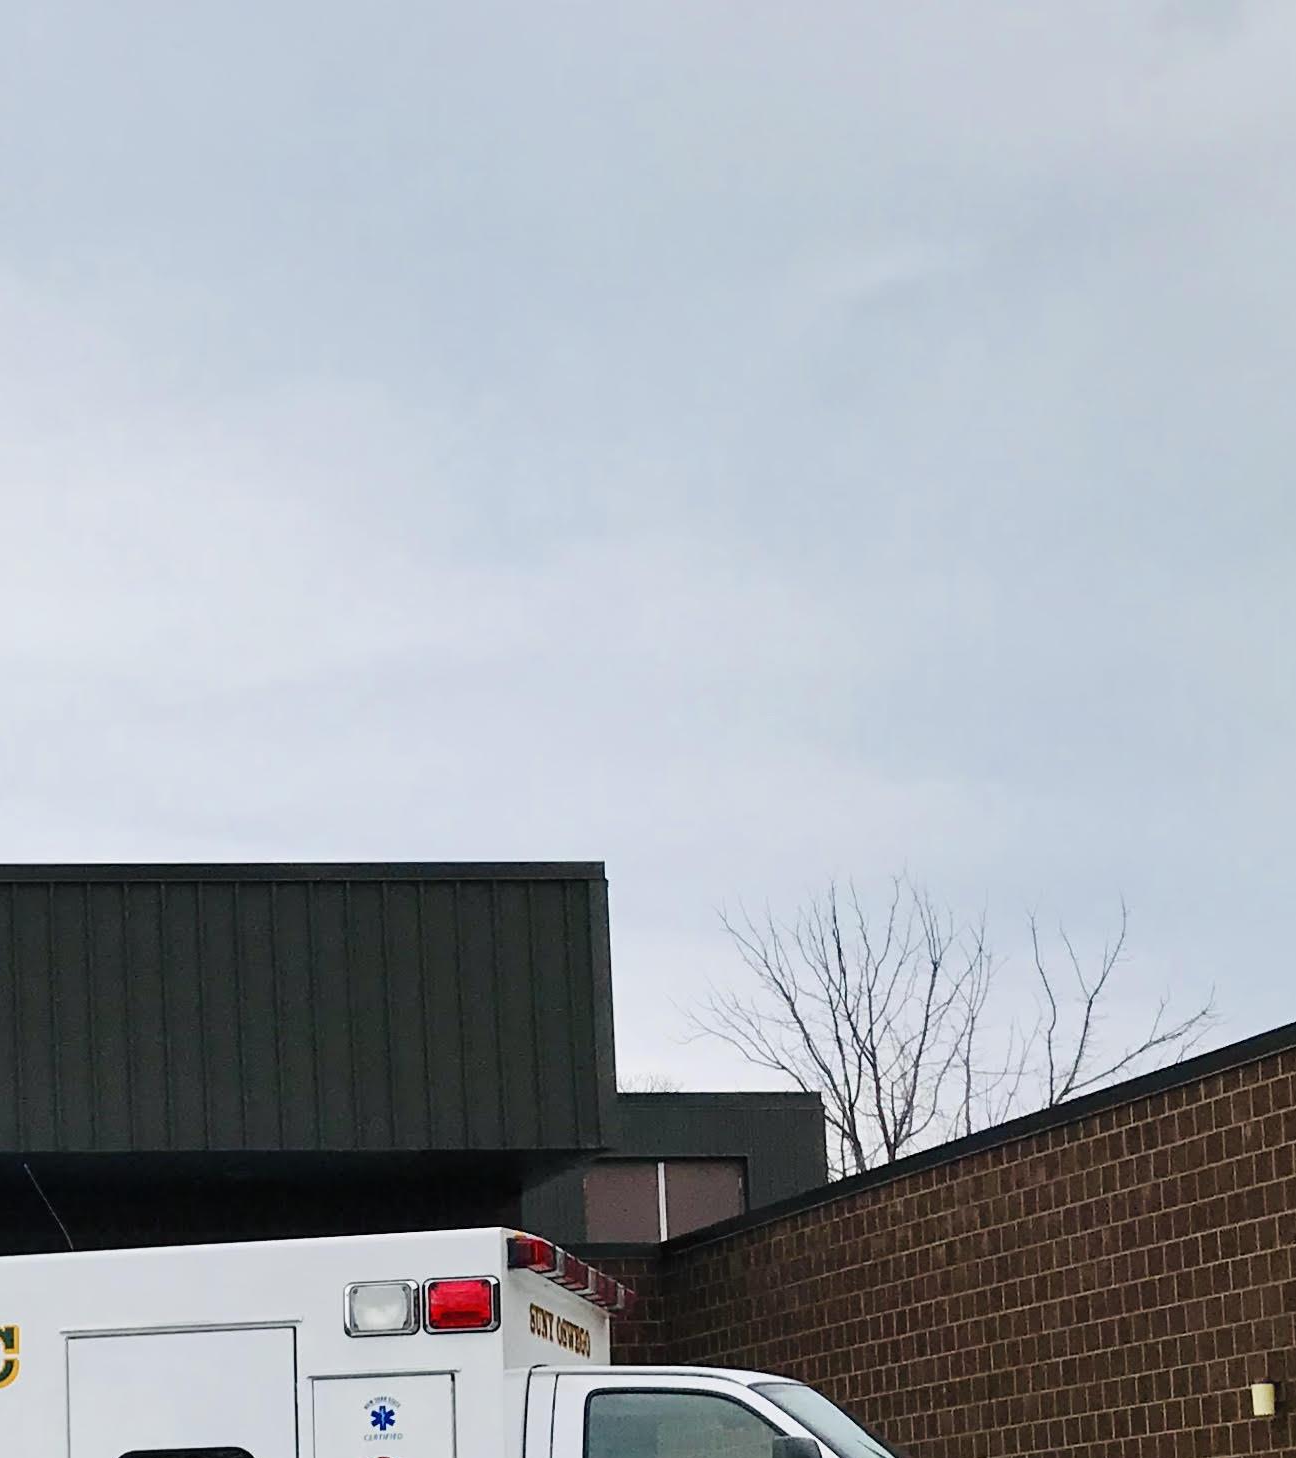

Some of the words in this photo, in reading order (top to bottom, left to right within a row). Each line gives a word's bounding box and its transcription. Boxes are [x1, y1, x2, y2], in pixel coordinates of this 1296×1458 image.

[530, 1303, 554, 1342] SUNY
[557, 1316, 590, 1358] OSWEGO
[363, 1432, 403, 1441] CERTIFIED
